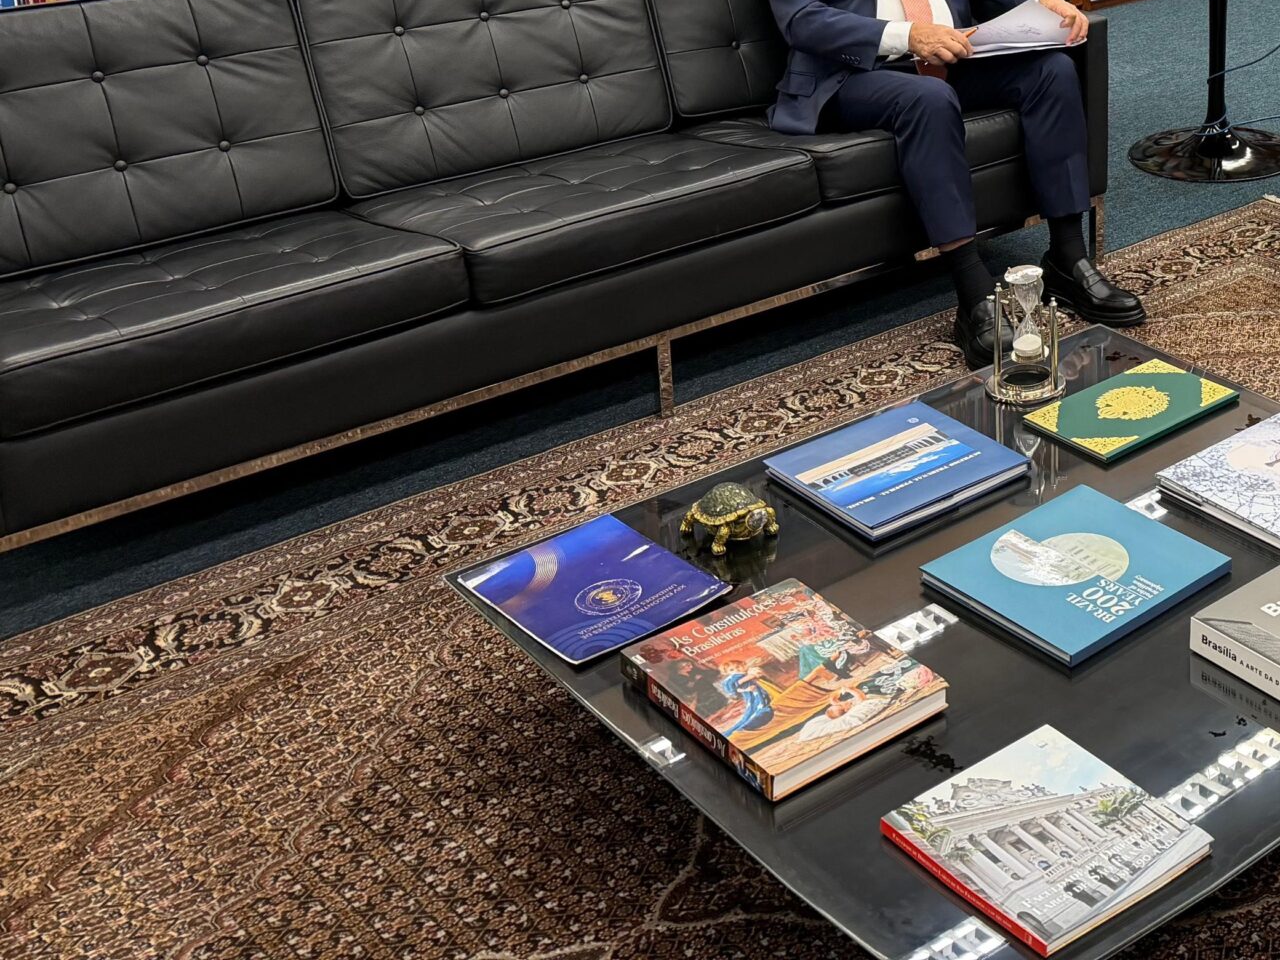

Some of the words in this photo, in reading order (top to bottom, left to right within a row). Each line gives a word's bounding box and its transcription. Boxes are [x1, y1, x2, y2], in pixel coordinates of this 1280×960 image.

[632, 591, 674, 616] ENCONTRO
[638, 583, 677, 605] UNIDADES
[1082, 587, 1135, 616] 200
[1097, 579, 1143, 606] YEARS
[1066, 592, 1117, 623] BRAZIL
[576, 607, 629, 637] INTELIGÊNCIA
[670, 635, 693, 649] As
[682, 626, 746, 657] Brasileiras
[1201, 634, 1237, 662] Brasília
[1246, 663, 1262, 676] ARTE
[1264, 673, 1273, 682] DA
[1133, 854, 1151, 869] 190
[1022, 869, 1084, 909] FACULDADE
[1032, 890, 1073, 916] LARGO
